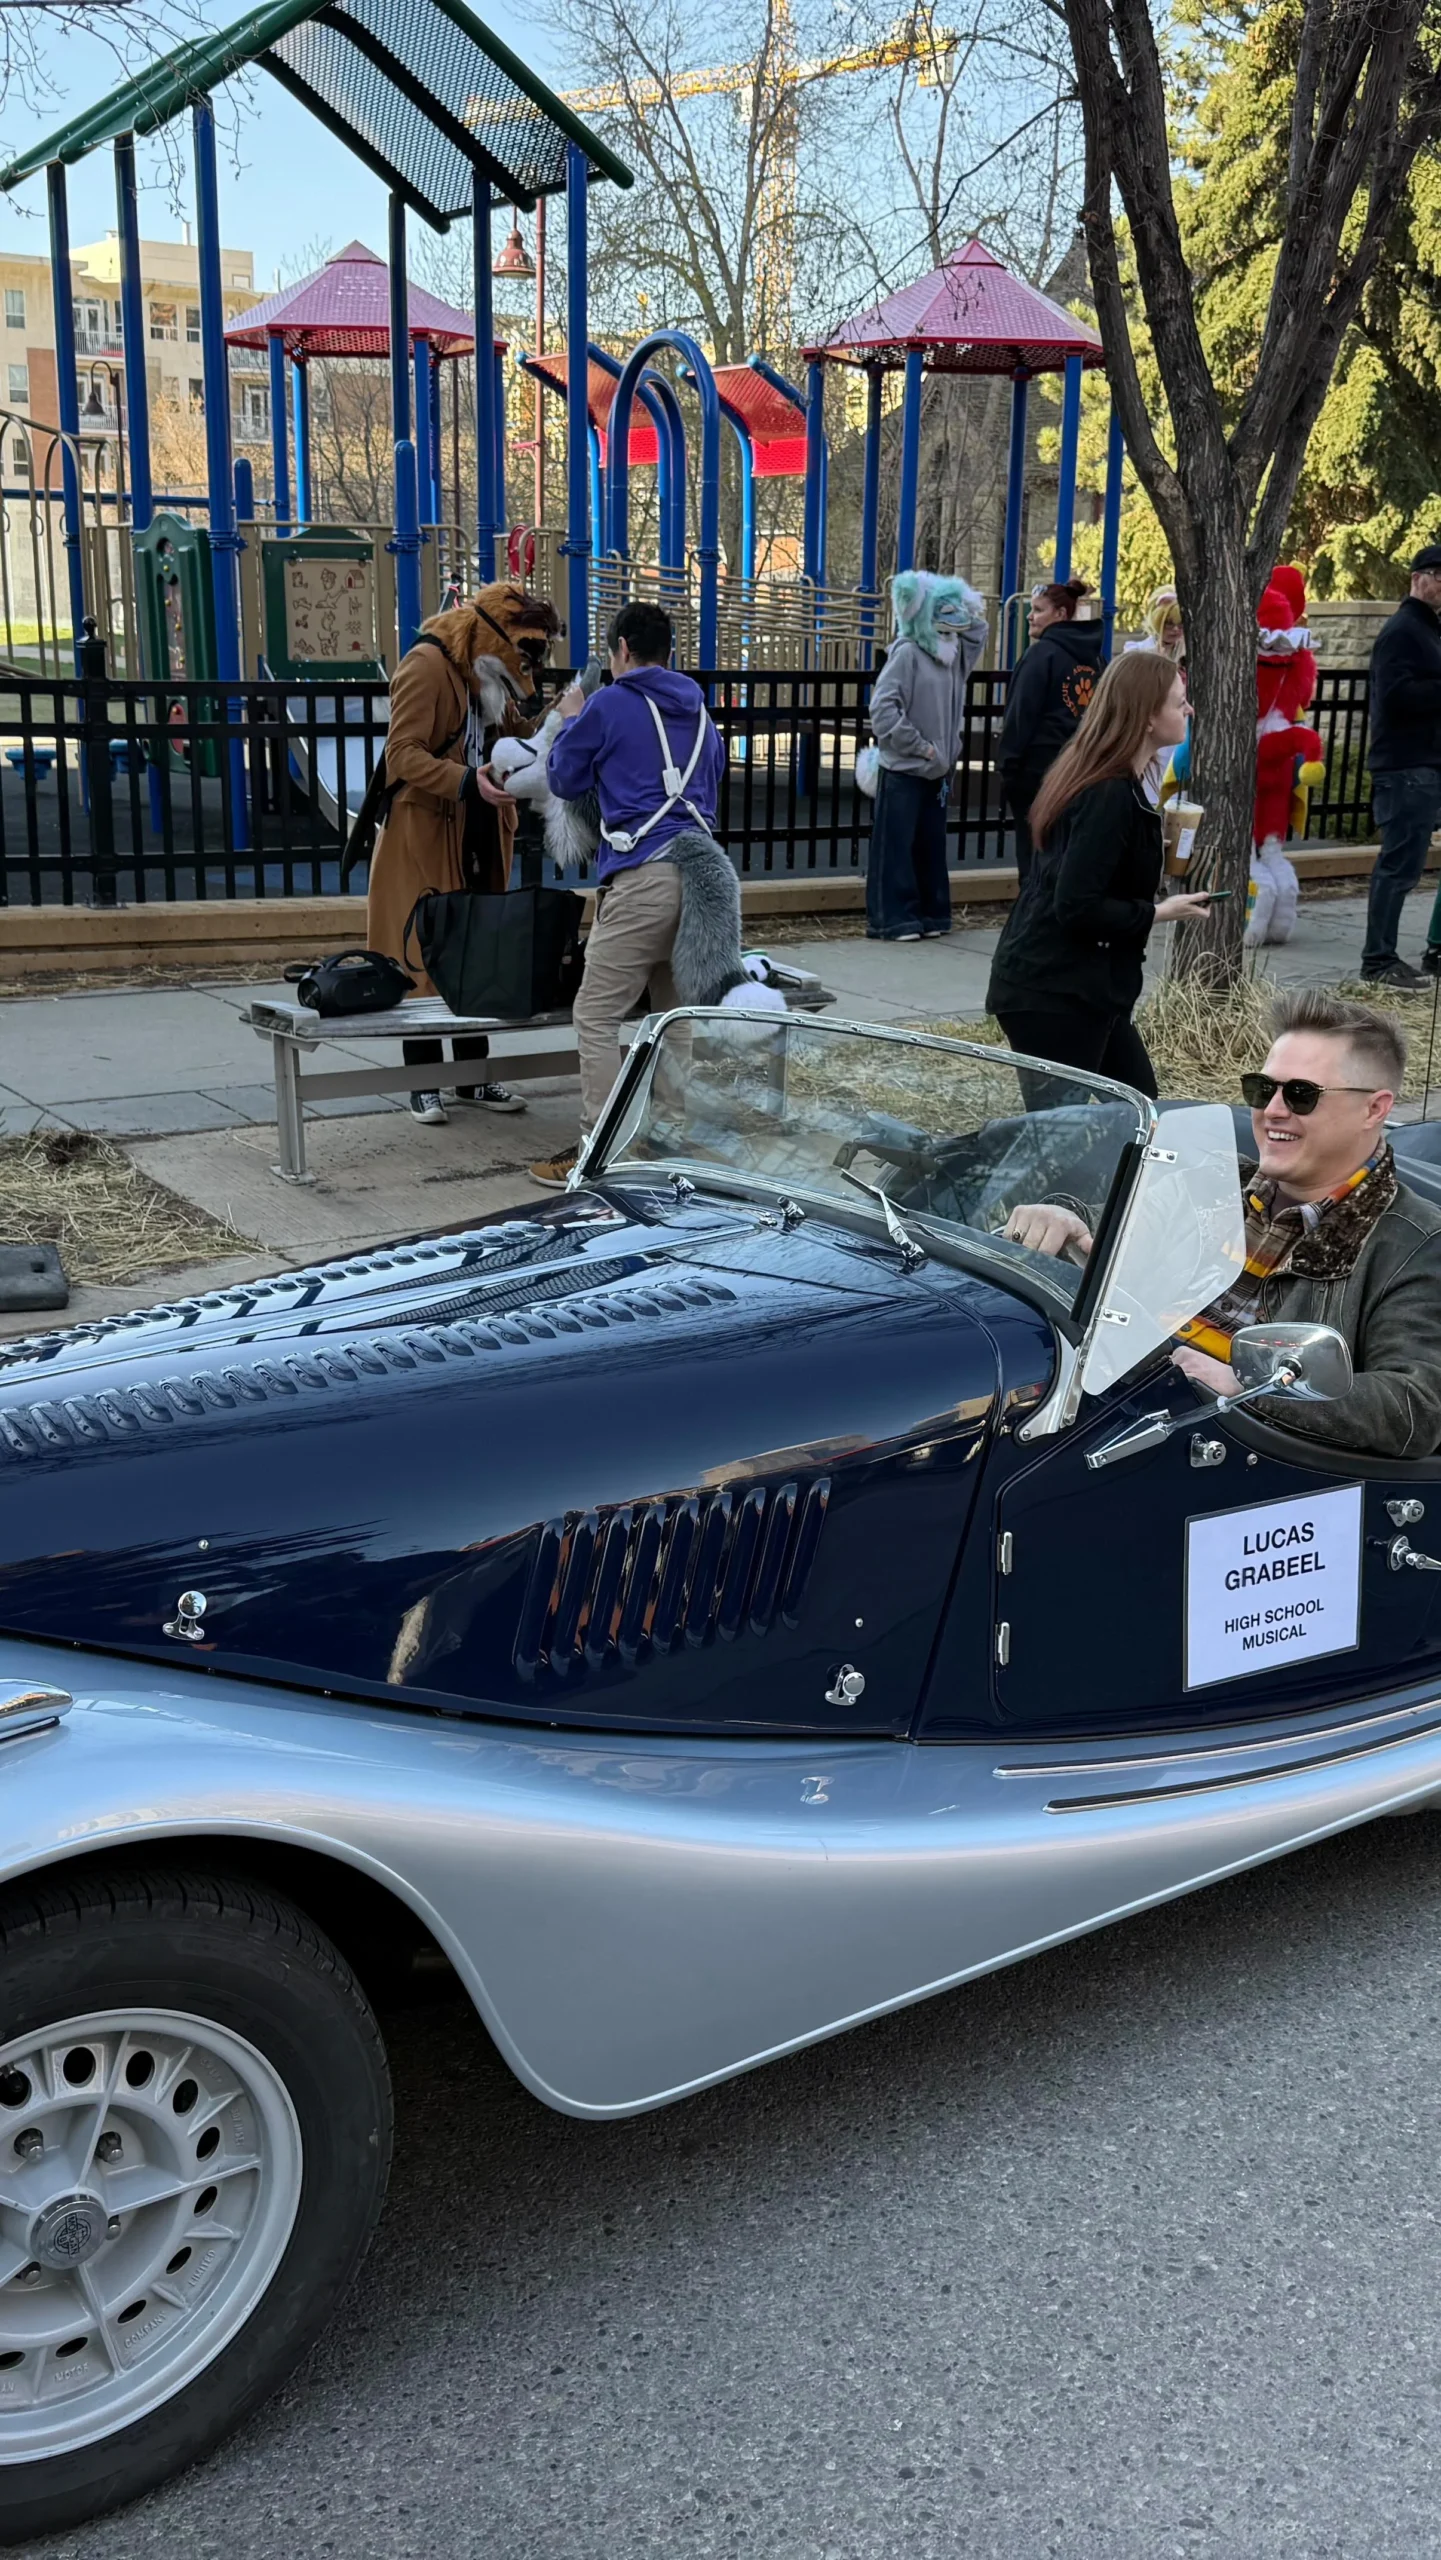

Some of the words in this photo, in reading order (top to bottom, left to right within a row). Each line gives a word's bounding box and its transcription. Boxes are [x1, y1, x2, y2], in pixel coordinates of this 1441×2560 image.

[1243, 1521, 1315, 1556] LUCAS
[1224, 1551, 1326, 1591] GRABEEL
[1224, 1613, 1261, 1634] HIGH
[1264, 1598, 1325, 1624] SCHOOL
[1242, 1623, 1307, 1651] MUSICAL
[67, 2215, 79, 2256] MORGAN
[124, 2311, 167, 2349] COMPANY
[188, 2248, 217, 2288] LIMITED
